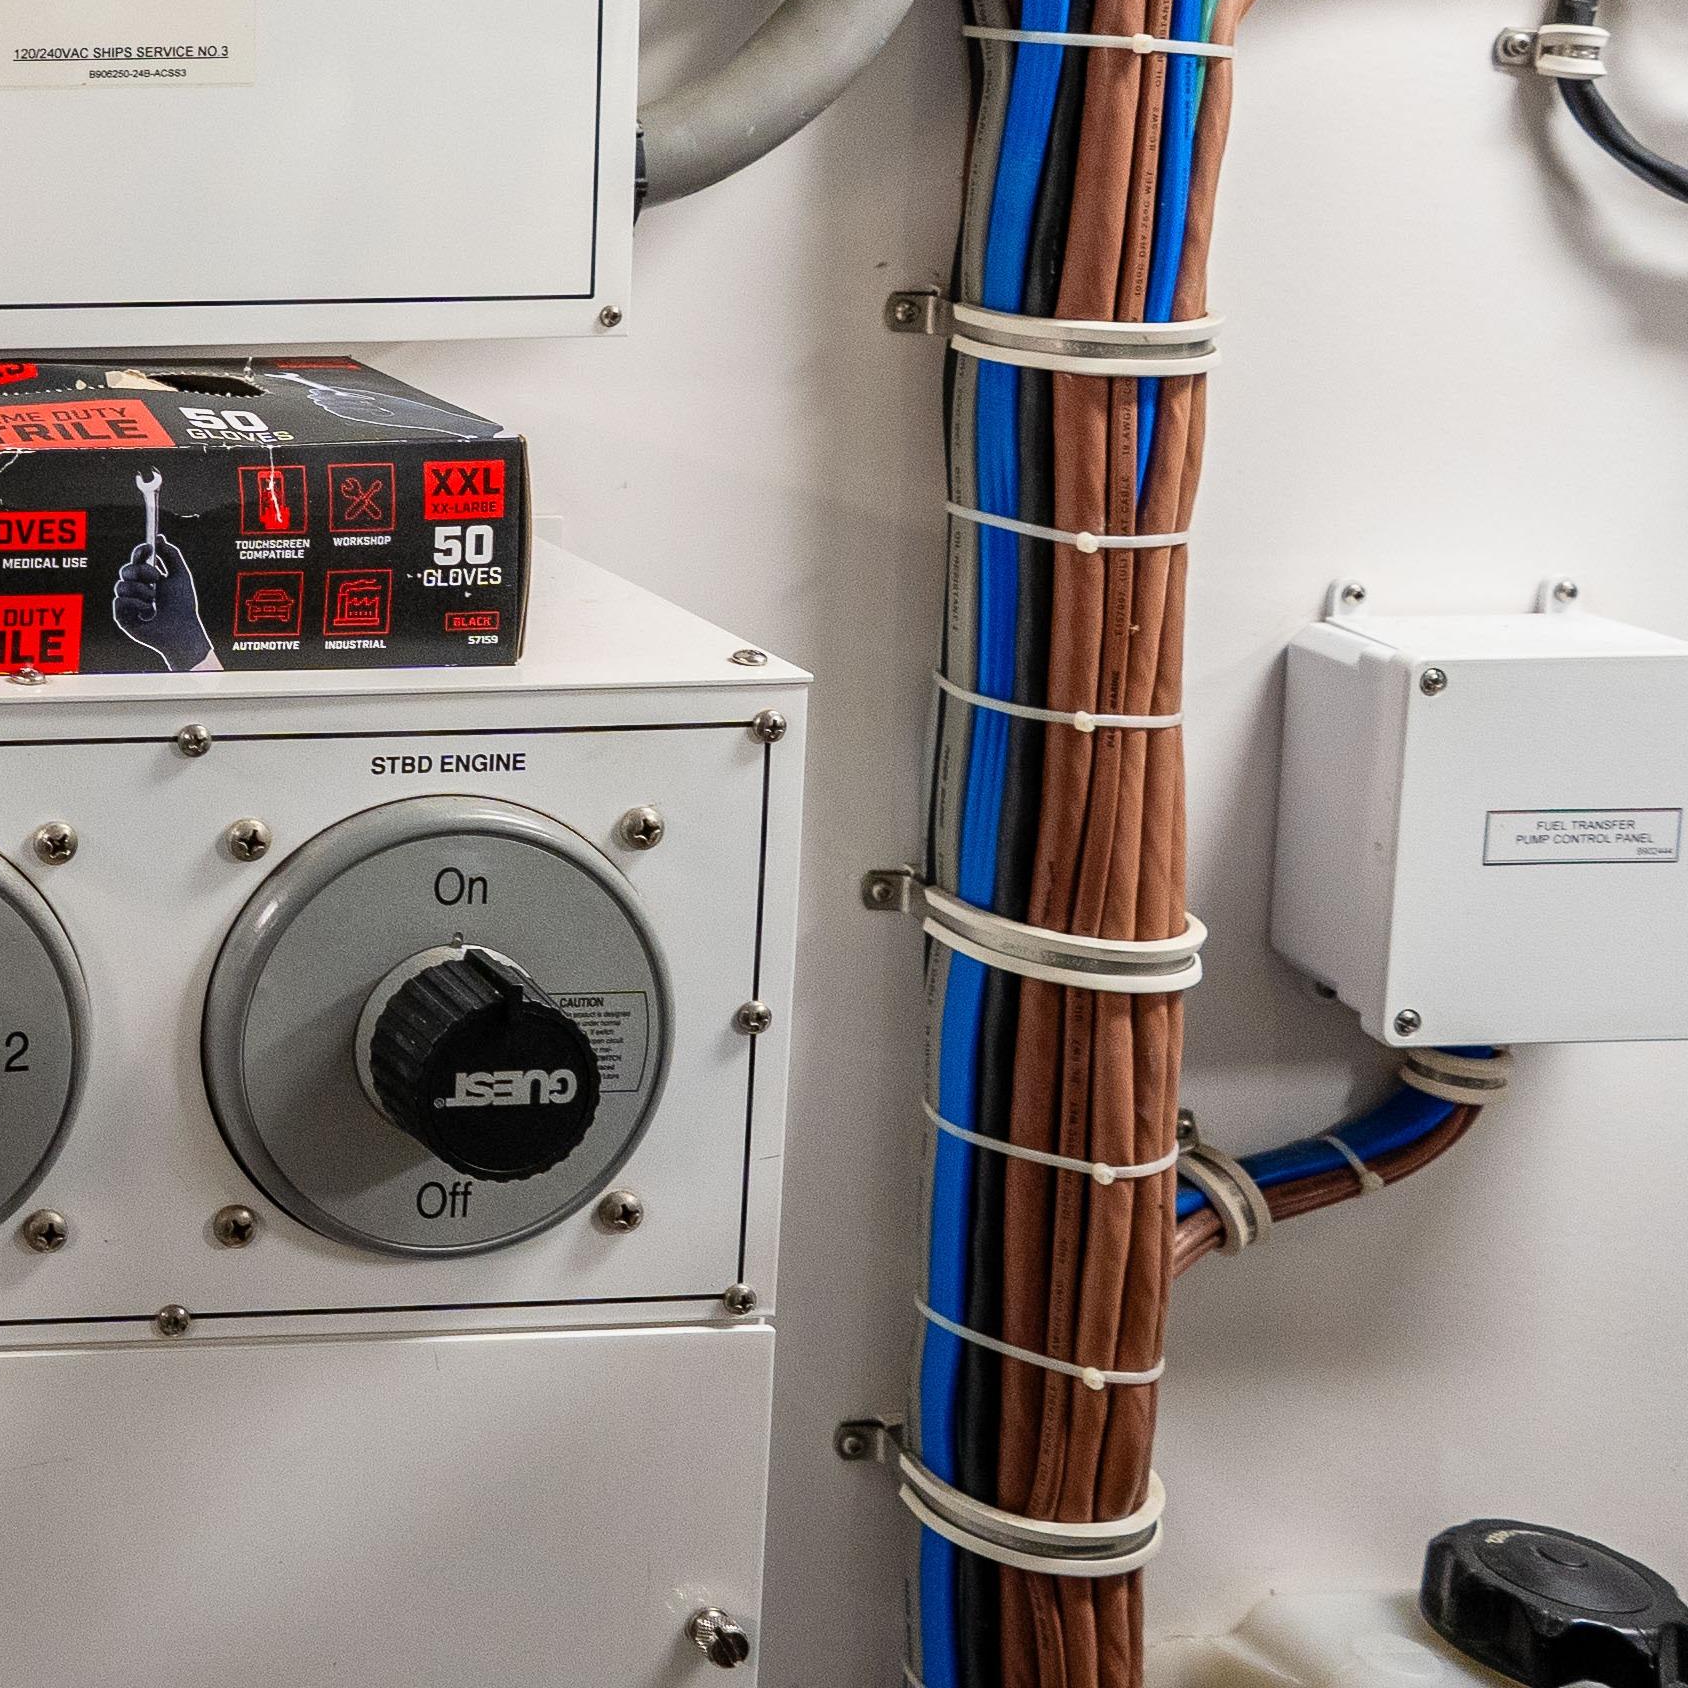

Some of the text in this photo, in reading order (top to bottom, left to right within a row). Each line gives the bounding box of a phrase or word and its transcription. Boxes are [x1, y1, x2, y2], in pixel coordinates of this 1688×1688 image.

[14, 45, 229, 61] 120/240VAC SHIPS SERVICE NO.3
[431, 467, 501, 497] XXL
[433, 524, 494, 566] 50
[2, 558, 60, 570] MEDICAL
[62, 557, 88, 569] USE
[423, 567, 502, 587] GLOVES
[3, 607, 66, 627] DUTY
[370, 752, 527, 775] STBD ENGINE
[1536, 819, 1636, 832] FUEL TRANSFER
[1515, 832, 1654, 845] PUMP CONTROL PANEL
[433, 868, 488, 906] On
[3, 1033, 30, 1072] 2
[416, 1182, 471, 1221] Off
